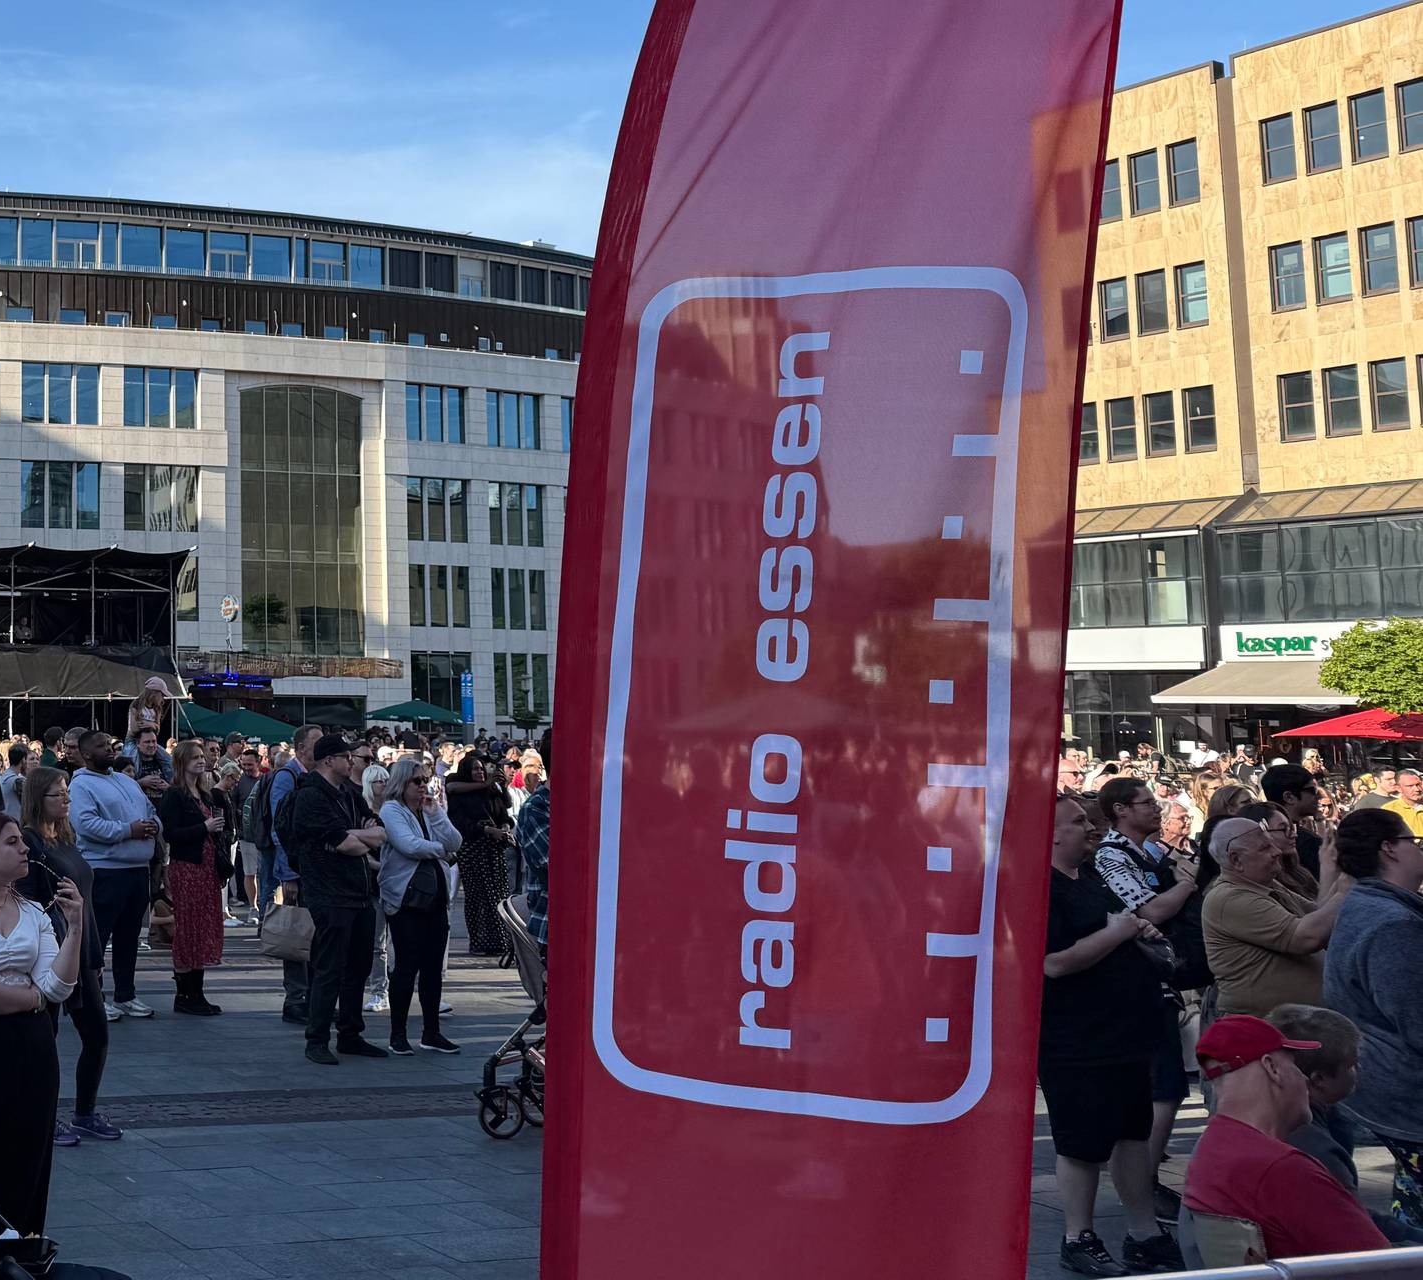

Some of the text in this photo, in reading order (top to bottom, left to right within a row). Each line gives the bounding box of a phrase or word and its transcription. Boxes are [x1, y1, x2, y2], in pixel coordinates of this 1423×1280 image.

[724, 331, 832, 1051] radio essen
[1235, 631, 1318, 656] kaspar
